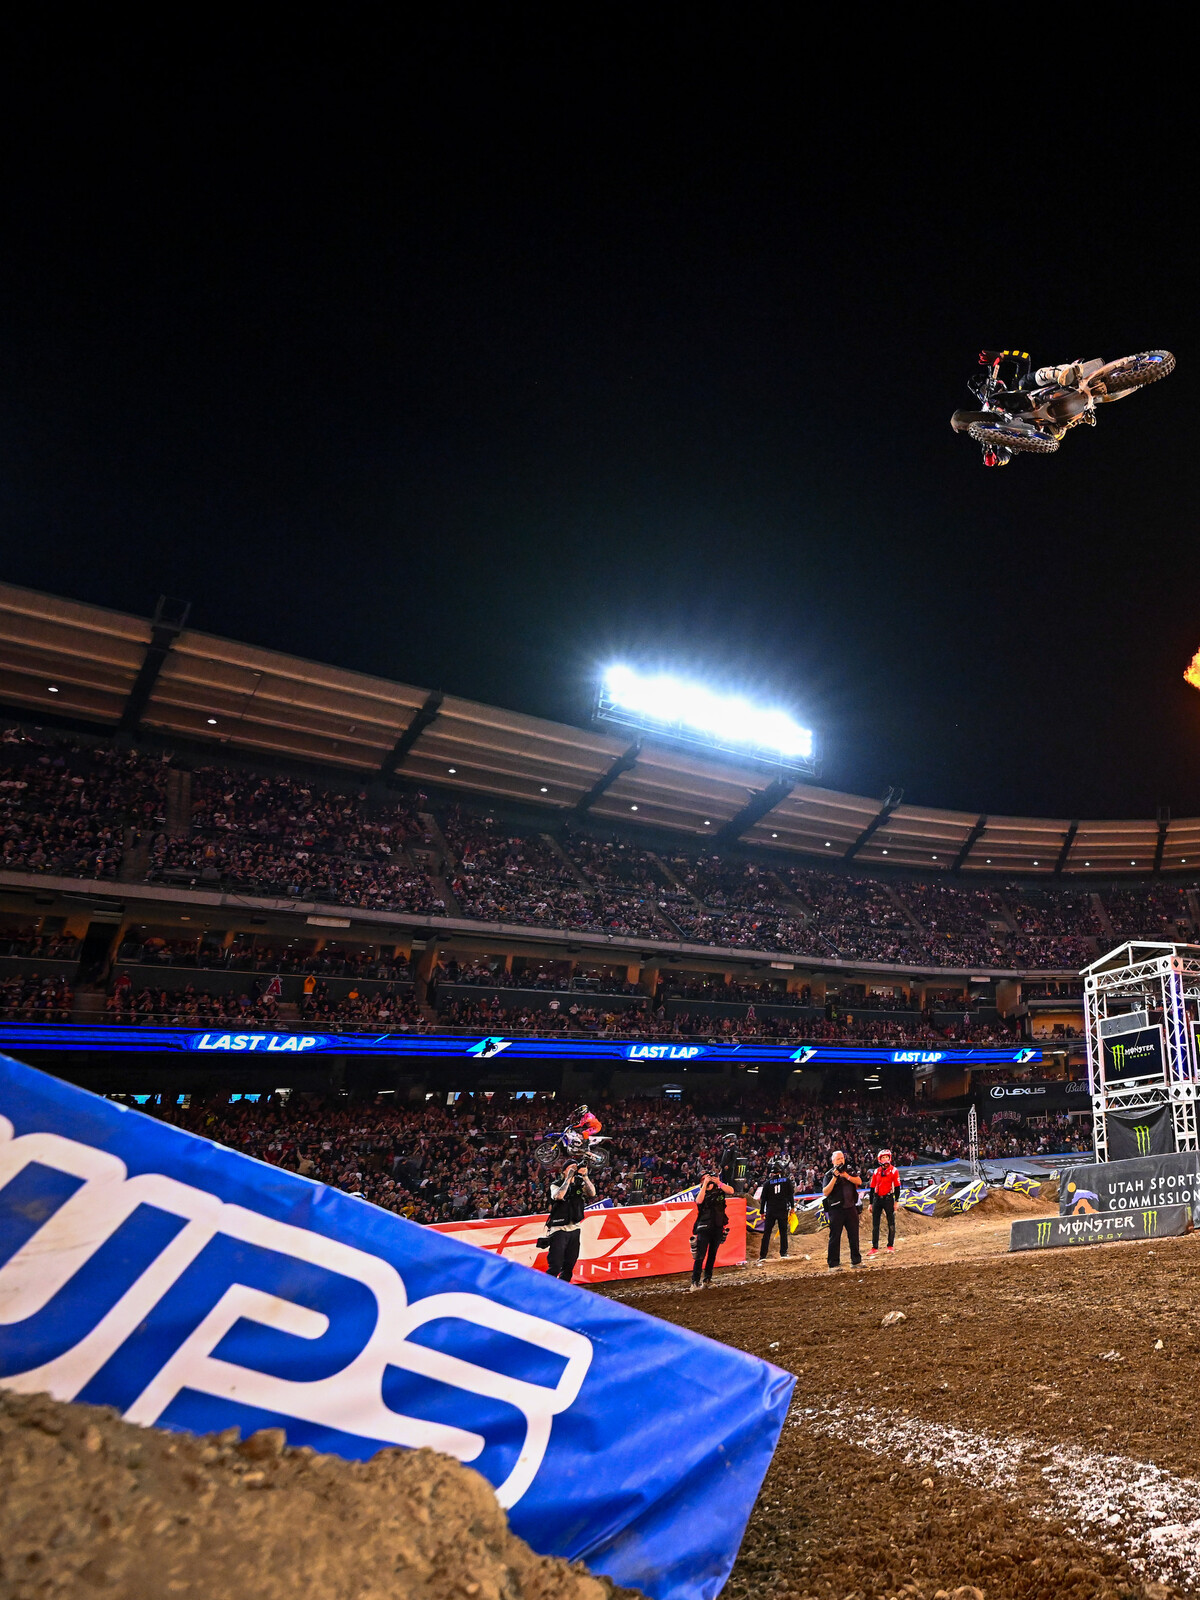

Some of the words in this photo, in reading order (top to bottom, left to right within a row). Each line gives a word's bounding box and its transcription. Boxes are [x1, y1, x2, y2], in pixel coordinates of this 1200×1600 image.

[198, 1034, 265, 1050] LAST
[267, 1036, 316, 1051] LAP
[629, 1045, 668, 1058] LAST
[670, 1046, 698, 1058] LAP
[1125, 1044, 1155, 1056] MONSTER
[894, 1052, 920, 1062] LAST
[921, 1052, 942, 1062] LAP
[1006, 1087, 1046, 1096] LEXUS
[1108, 1180, 1144, 1194] UTAH
[1150, 1172, 1200, 1189] SPORTS
[774, 1184, 781, 1195] 11
[1058, 1216, 1135, 1236] MONSTER
[1069, 1233, 1123, 1243] ENERGY
